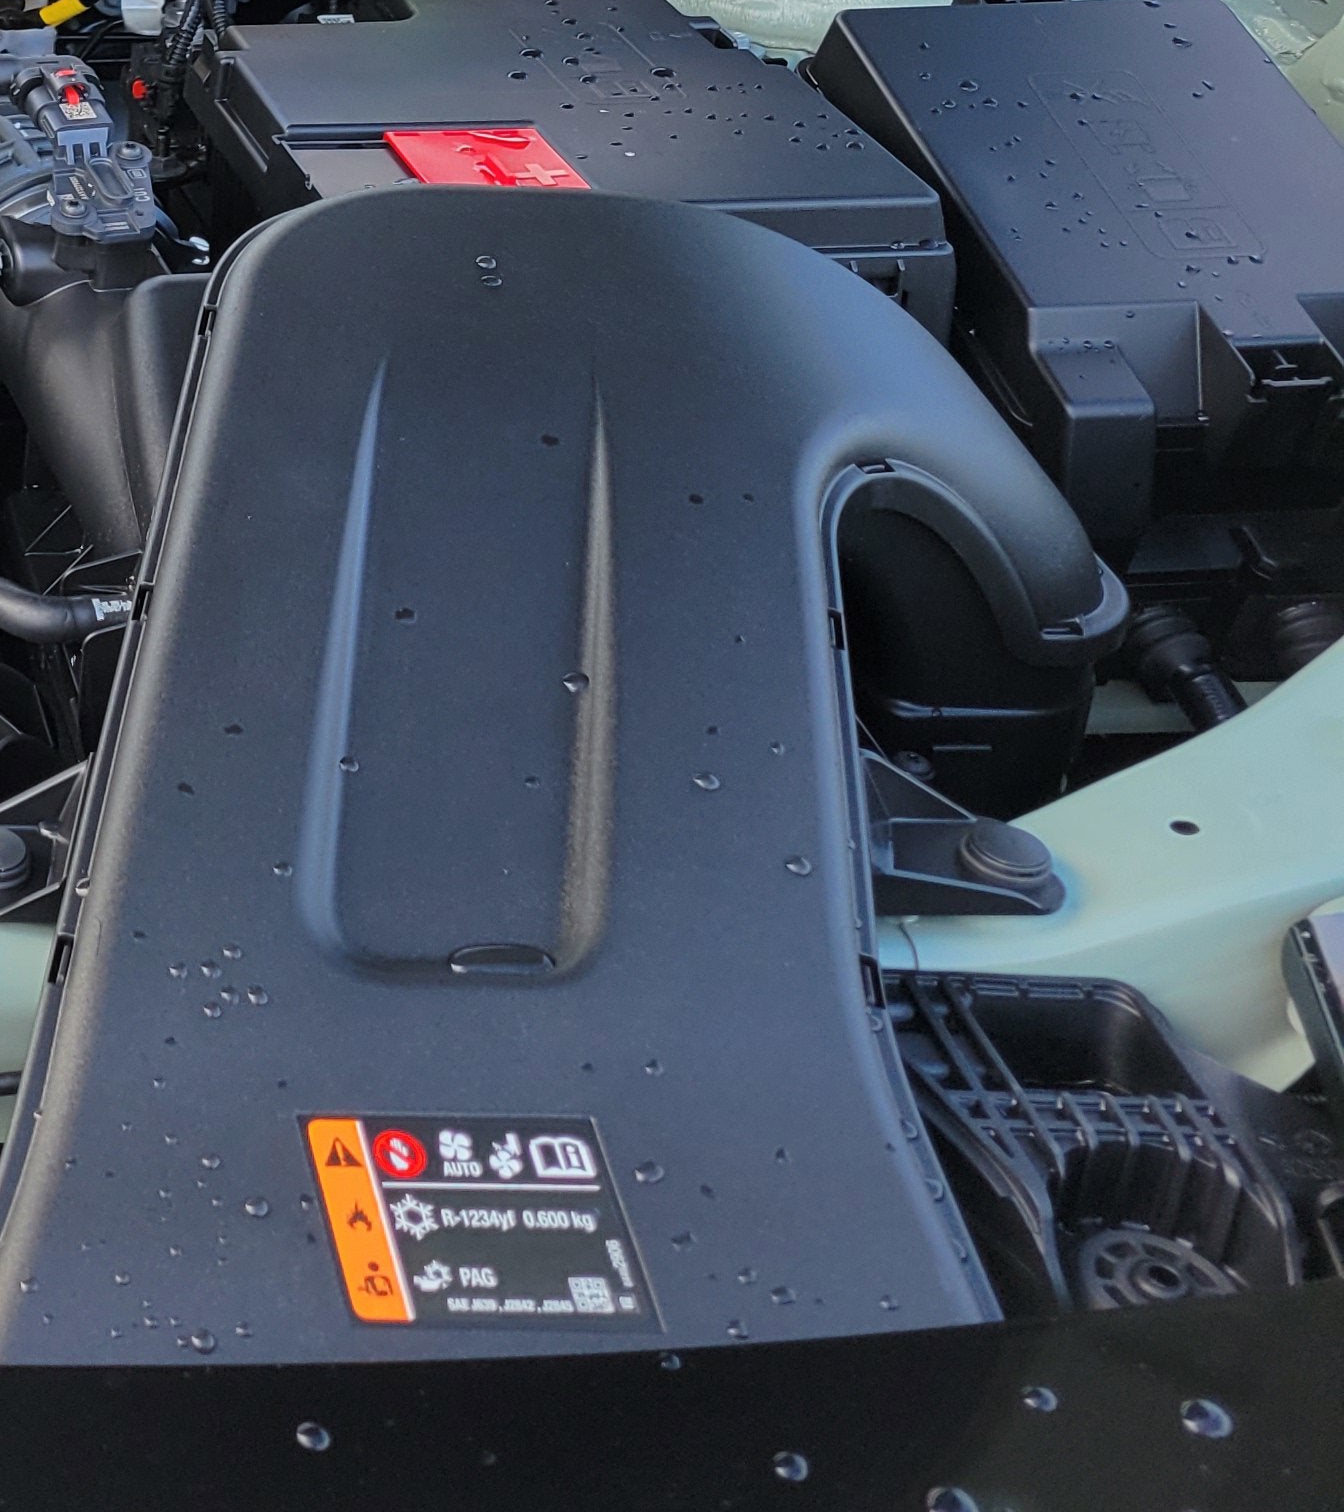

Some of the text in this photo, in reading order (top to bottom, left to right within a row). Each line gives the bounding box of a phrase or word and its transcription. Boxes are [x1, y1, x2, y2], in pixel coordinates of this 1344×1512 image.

[443, 1160, 483, 1178] AUTO
[441, 1208, 595, 1233] R-1234yf 0.600 kg
[459, 1267, 498, 1289] PAG
